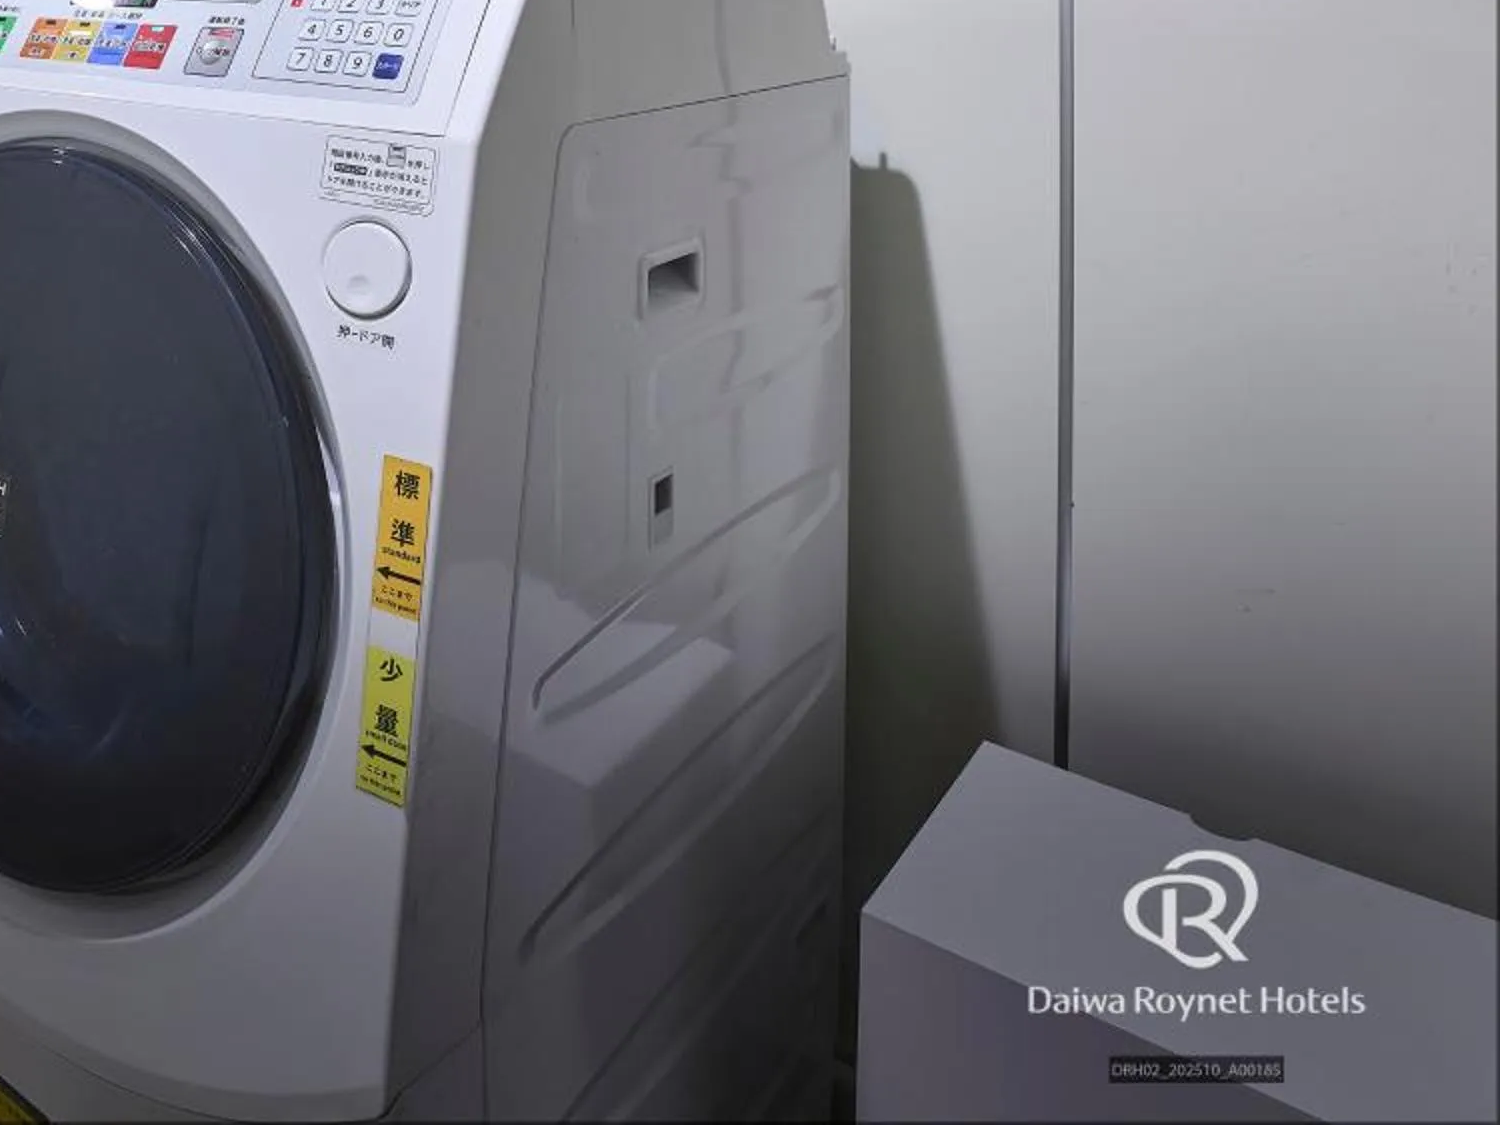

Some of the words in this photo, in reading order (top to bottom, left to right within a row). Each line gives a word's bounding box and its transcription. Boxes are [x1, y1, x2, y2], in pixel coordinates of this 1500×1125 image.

[307, 24, 317, 35] 4
[334, 25, 345, 36] 5
[362, 26, 373, 38] 6
[392, 28, 404, 40] 0
[297, 53, 306, 66] 7
[323, 54, 333, 67] 8
[353, 57, 363, 70] 9
[390, 470, 421, 548] 標準
[375, 657, 404, 738] 少量
